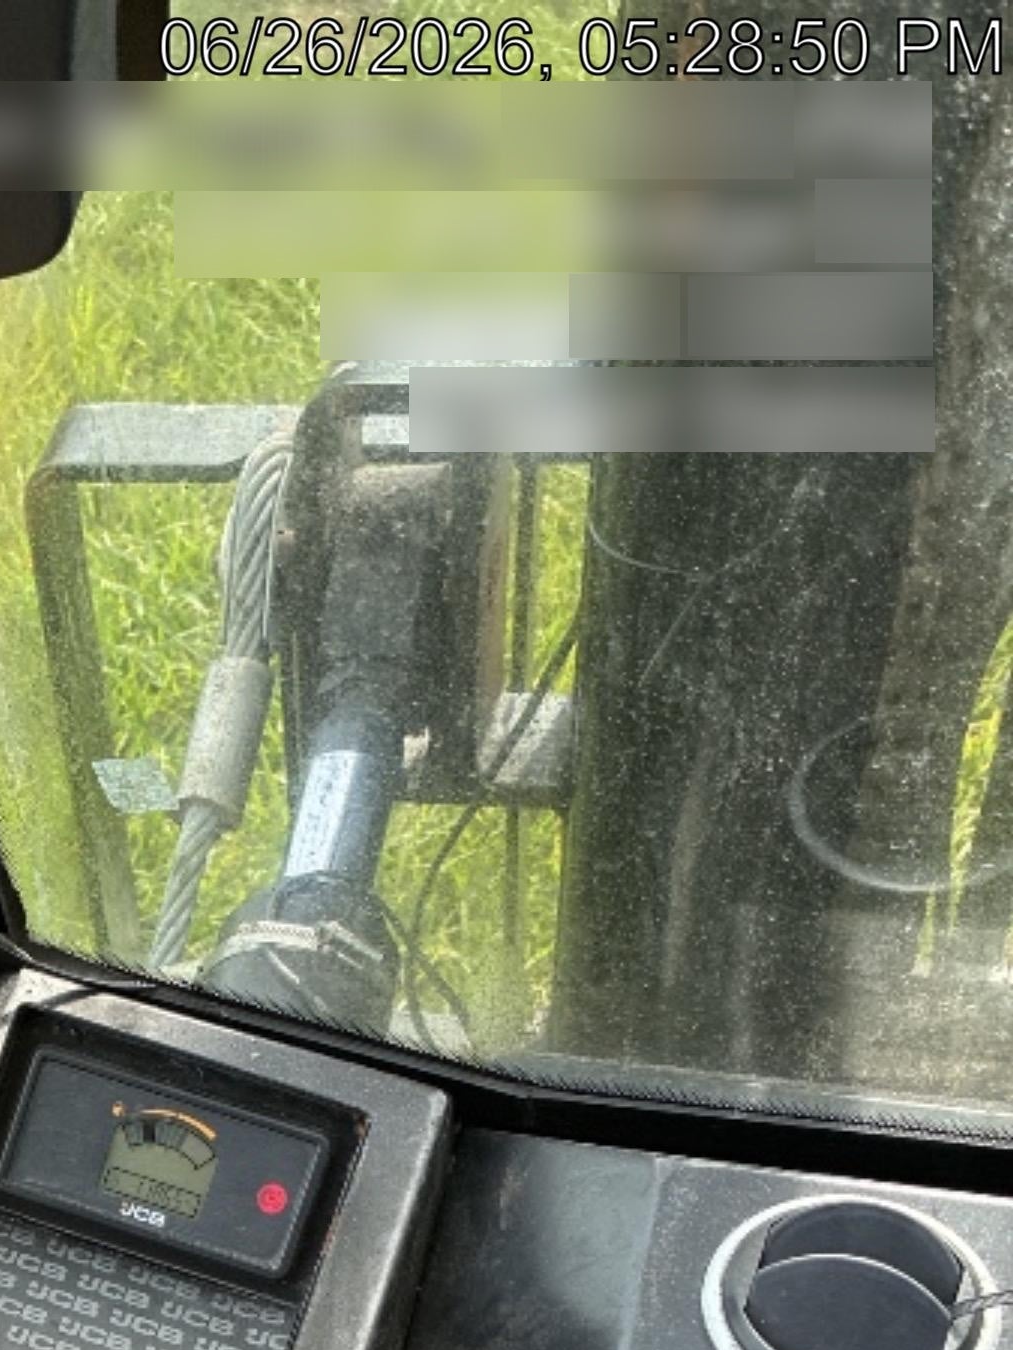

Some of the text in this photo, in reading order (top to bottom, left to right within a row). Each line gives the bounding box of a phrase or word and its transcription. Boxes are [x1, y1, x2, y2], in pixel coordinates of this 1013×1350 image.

[119, 1202, 165, 1227] JCB
[26, 1280, 98, 1317] JCB
[109, 1309, 183, 1345] JCB
[78, 1275, 150, 1309] JCB
[161, 1301, 234, 1336] JCB
[245, 1328, 290, 1350] JC
